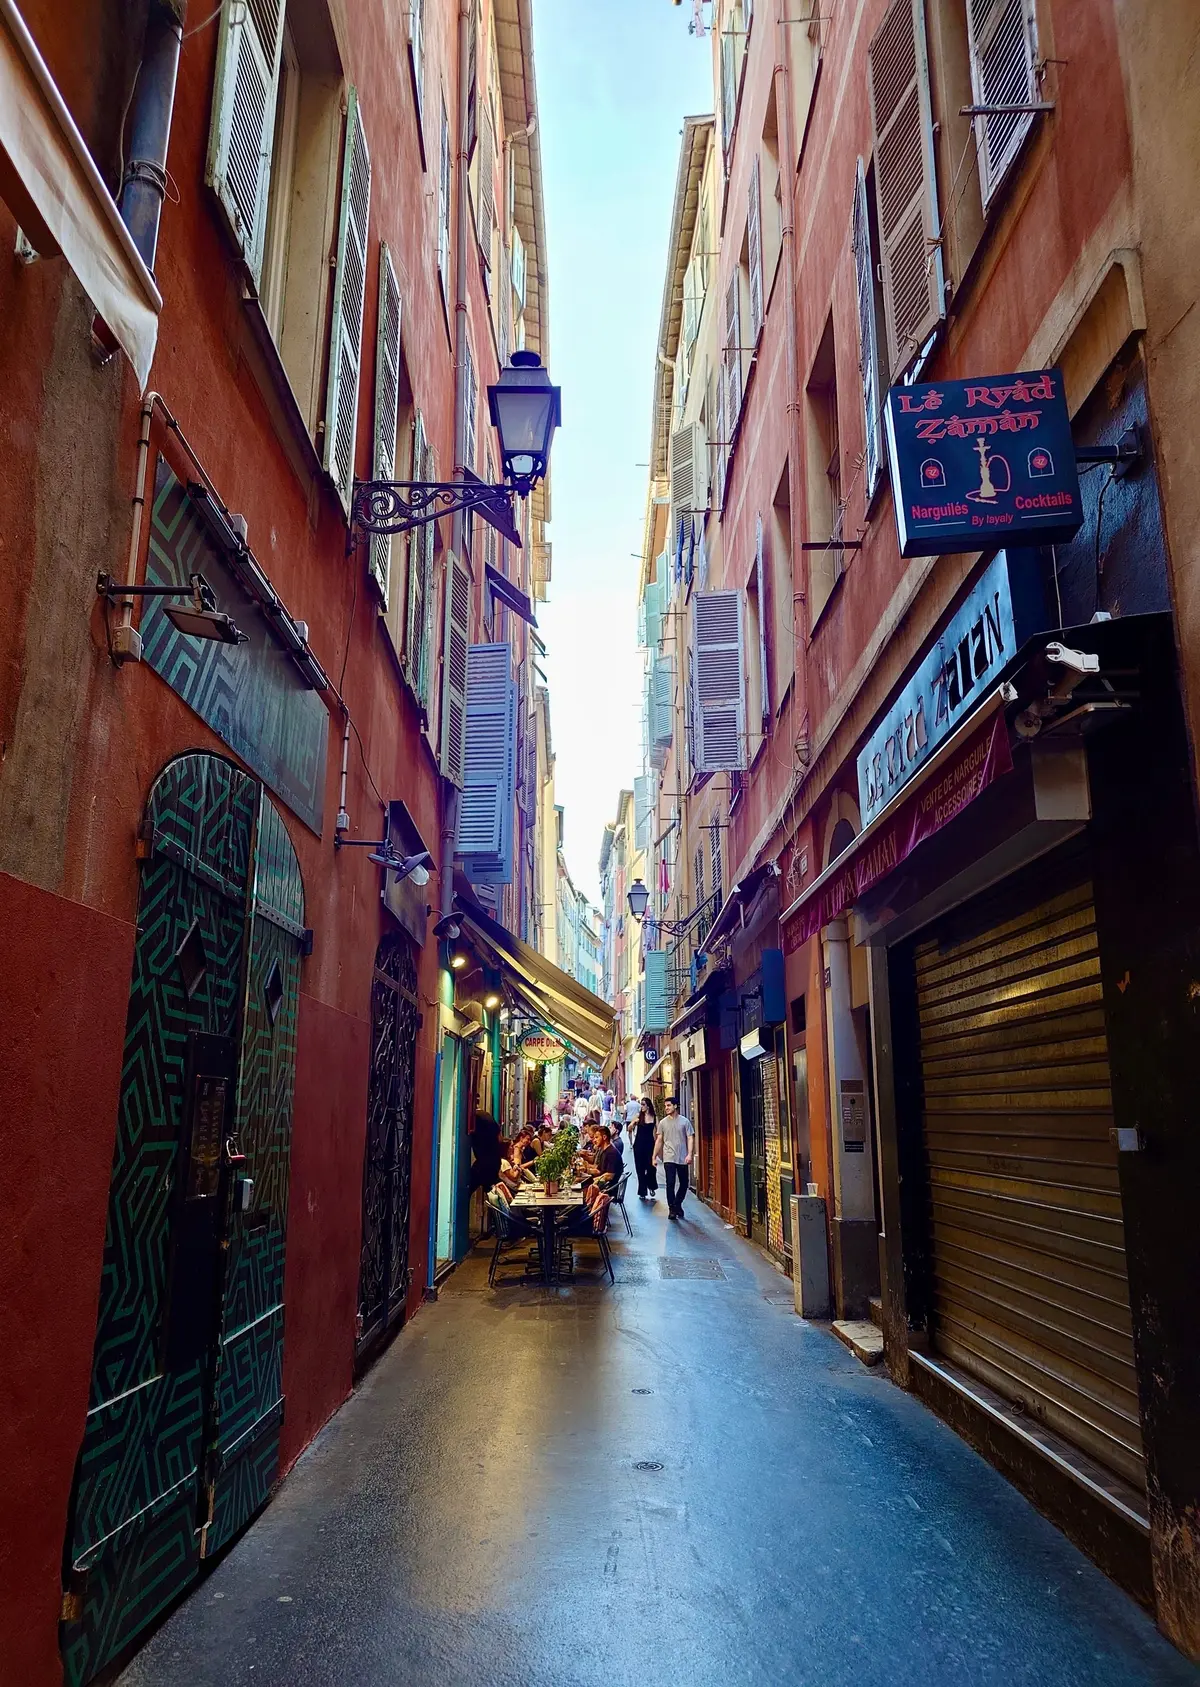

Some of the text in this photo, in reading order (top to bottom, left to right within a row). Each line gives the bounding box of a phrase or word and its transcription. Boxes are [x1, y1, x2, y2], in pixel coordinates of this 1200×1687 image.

[911, 492, 1073, 520] Narguilés Cocktails
[971, 515, 985, 526] By
[920, 783, 943, 814] VENTE
[943, 772, 954, 794] DE
[525, 1037, 545, 1047] CARPE
